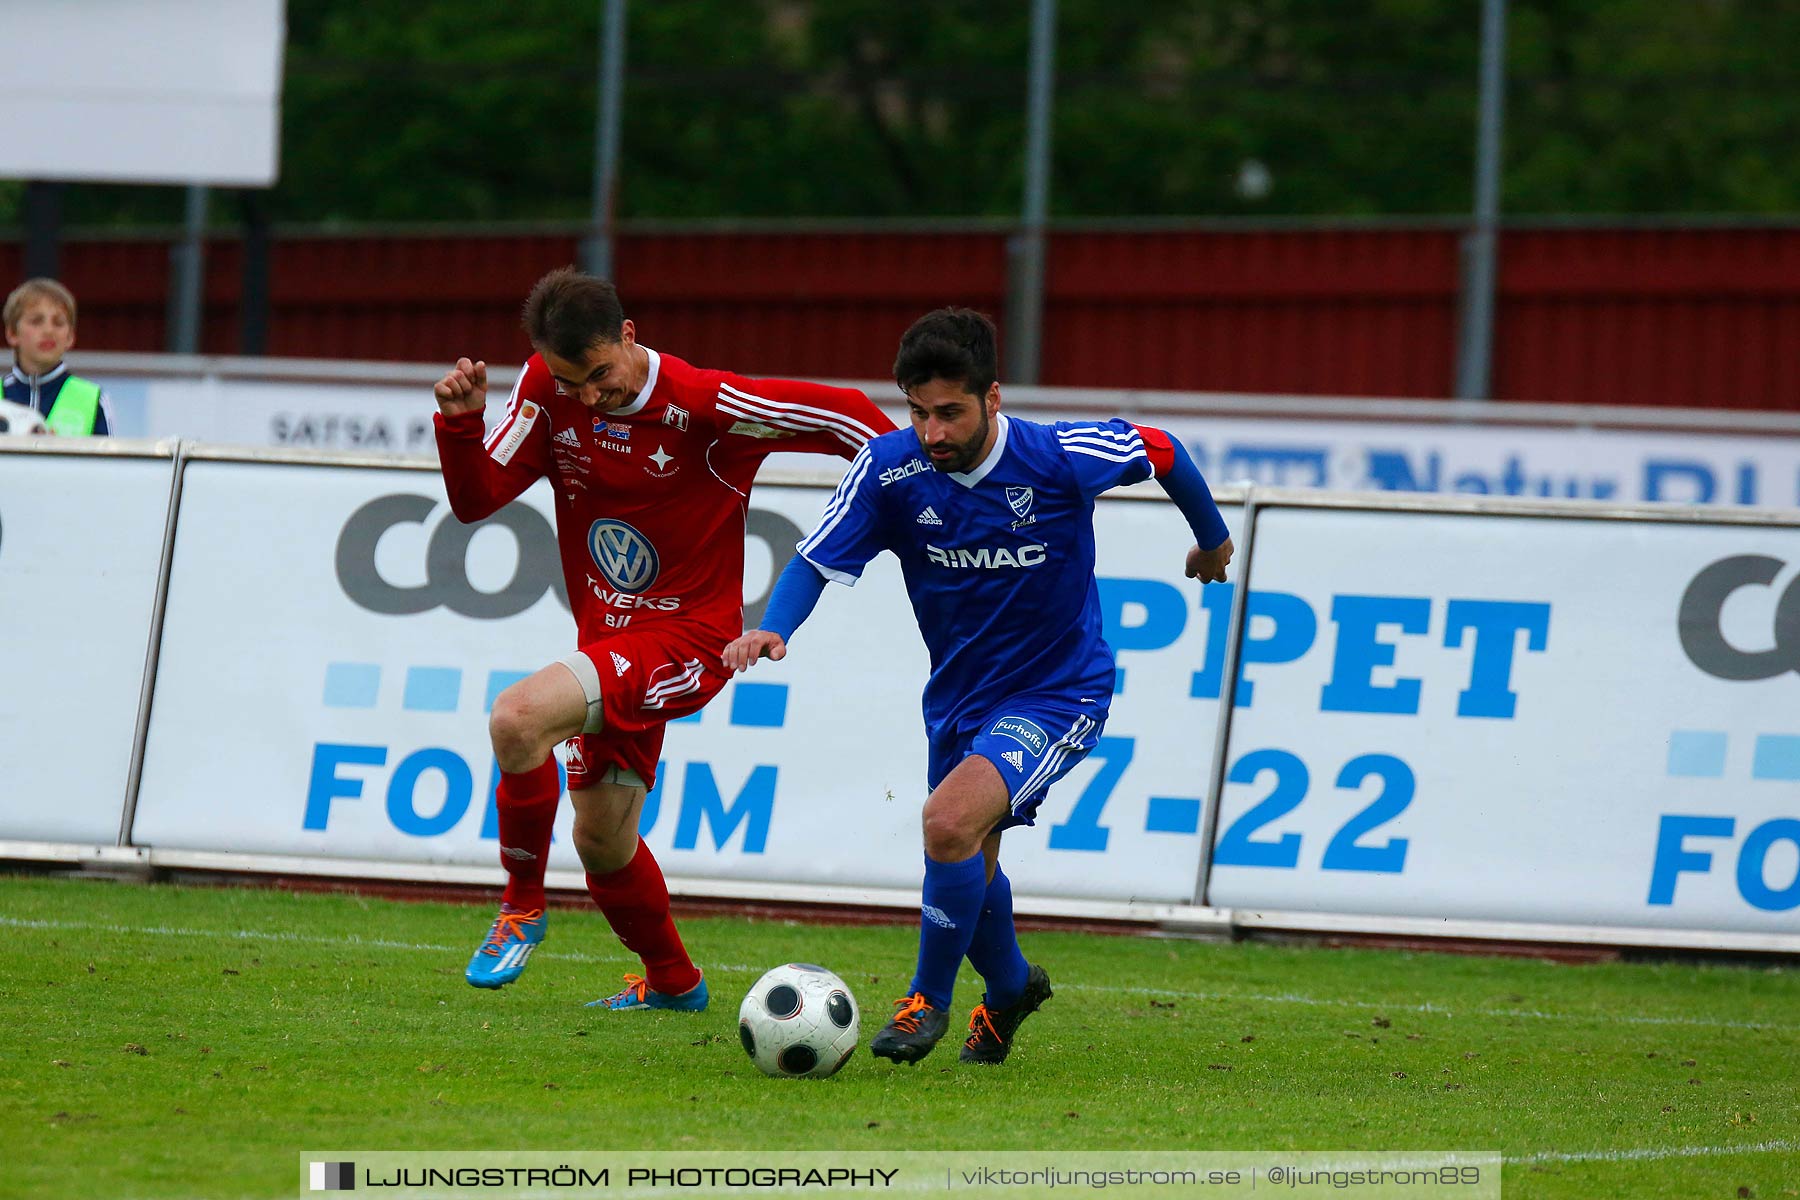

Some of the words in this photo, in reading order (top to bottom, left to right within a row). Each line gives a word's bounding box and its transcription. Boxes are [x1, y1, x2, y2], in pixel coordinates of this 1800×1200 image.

[1093, 577, 1551, 719] PPET
[997, 721, 1042, 749] Furhoffs
[302, 743, 779, 853] FOM
